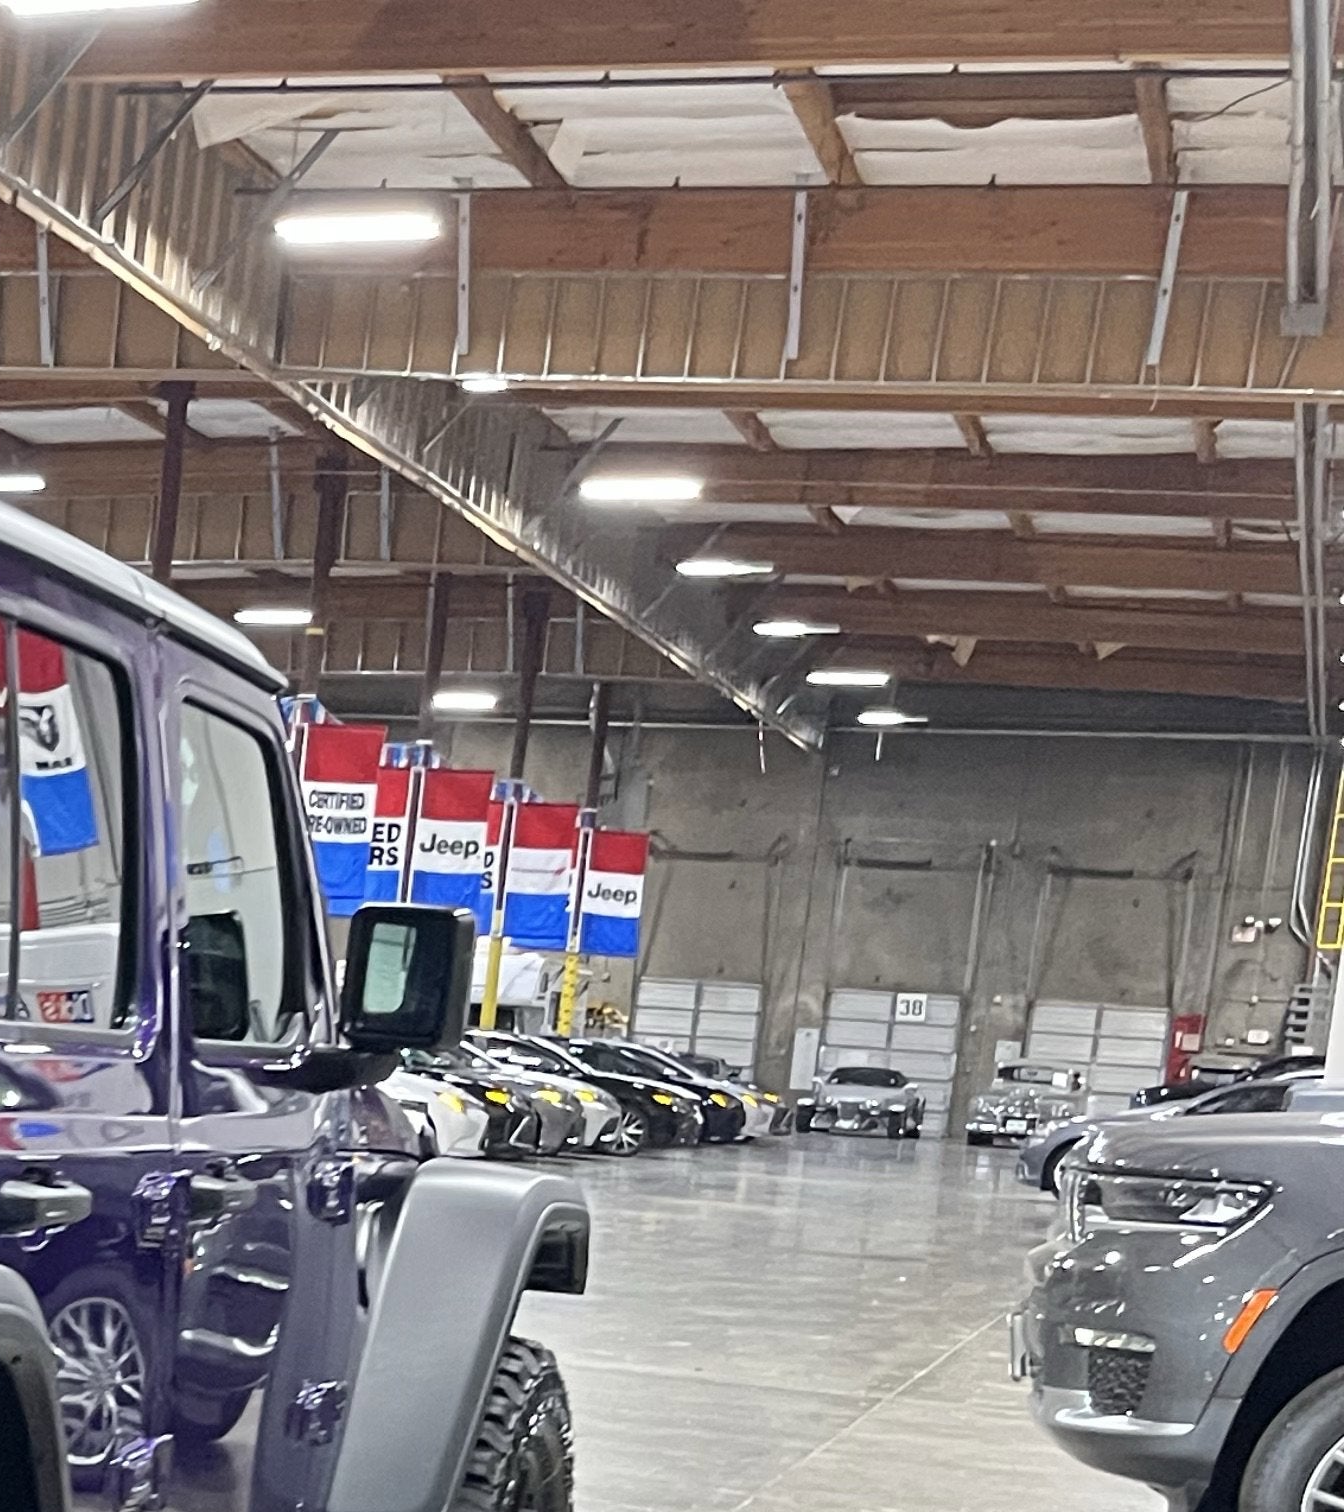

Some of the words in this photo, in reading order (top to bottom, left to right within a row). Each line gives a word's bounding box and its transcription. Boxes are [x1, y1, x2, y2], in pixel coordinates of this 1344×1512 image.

[419, 833, 479, 860] Jeep
[587, 883, 637, 905] Jeep
[899, 999, 923, 1016] 38
